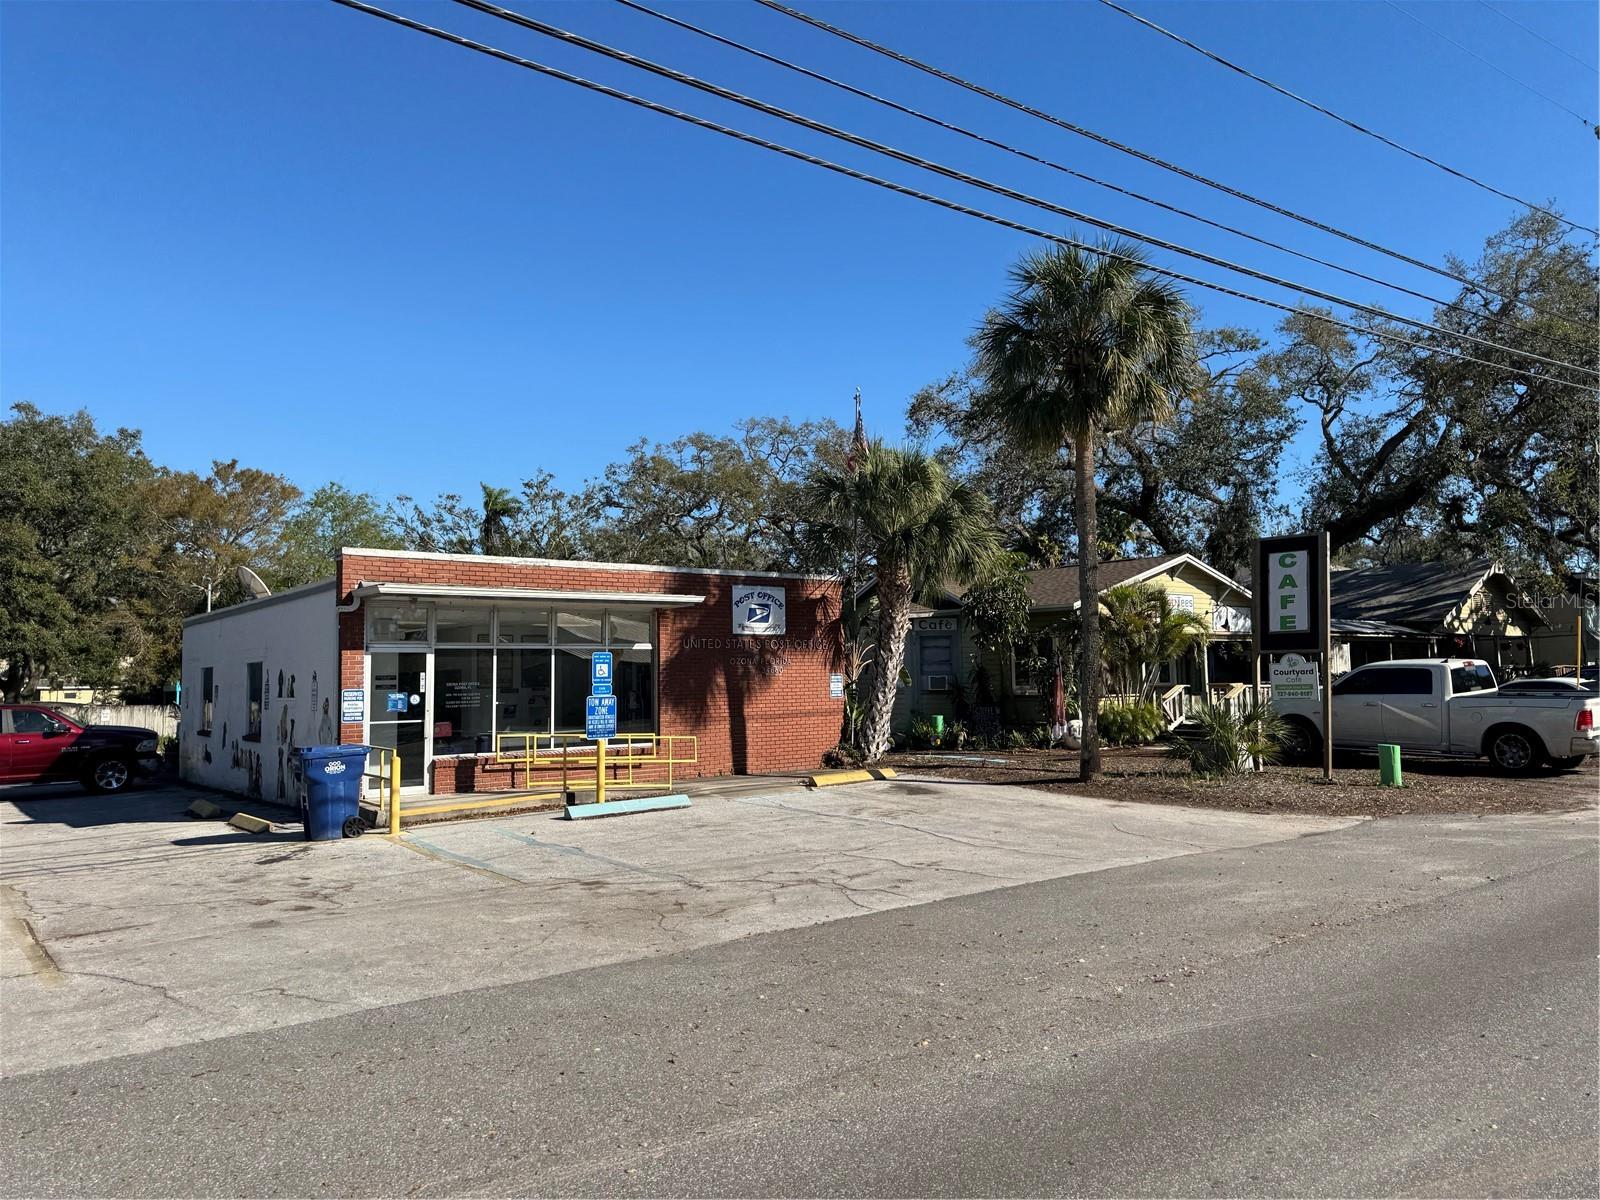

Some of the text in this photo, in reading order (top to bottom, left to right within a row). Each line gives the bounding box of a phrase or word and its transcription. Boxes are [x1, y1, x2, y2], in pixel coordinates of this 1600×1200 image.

[1279, 552, 1298, 630] CAFE
[734, 591, 785, 611] POST OFFICE
[682, 638, 829, 650] UNITED STATES POST OFFICE
[729, 657, 791, 665] OZONA FLORIDA
[1273, 668, 1314, 677] Courtyard
[588, 697, 615, 707] TOW AWAY
[595, 706, 609, 715] ZONE
